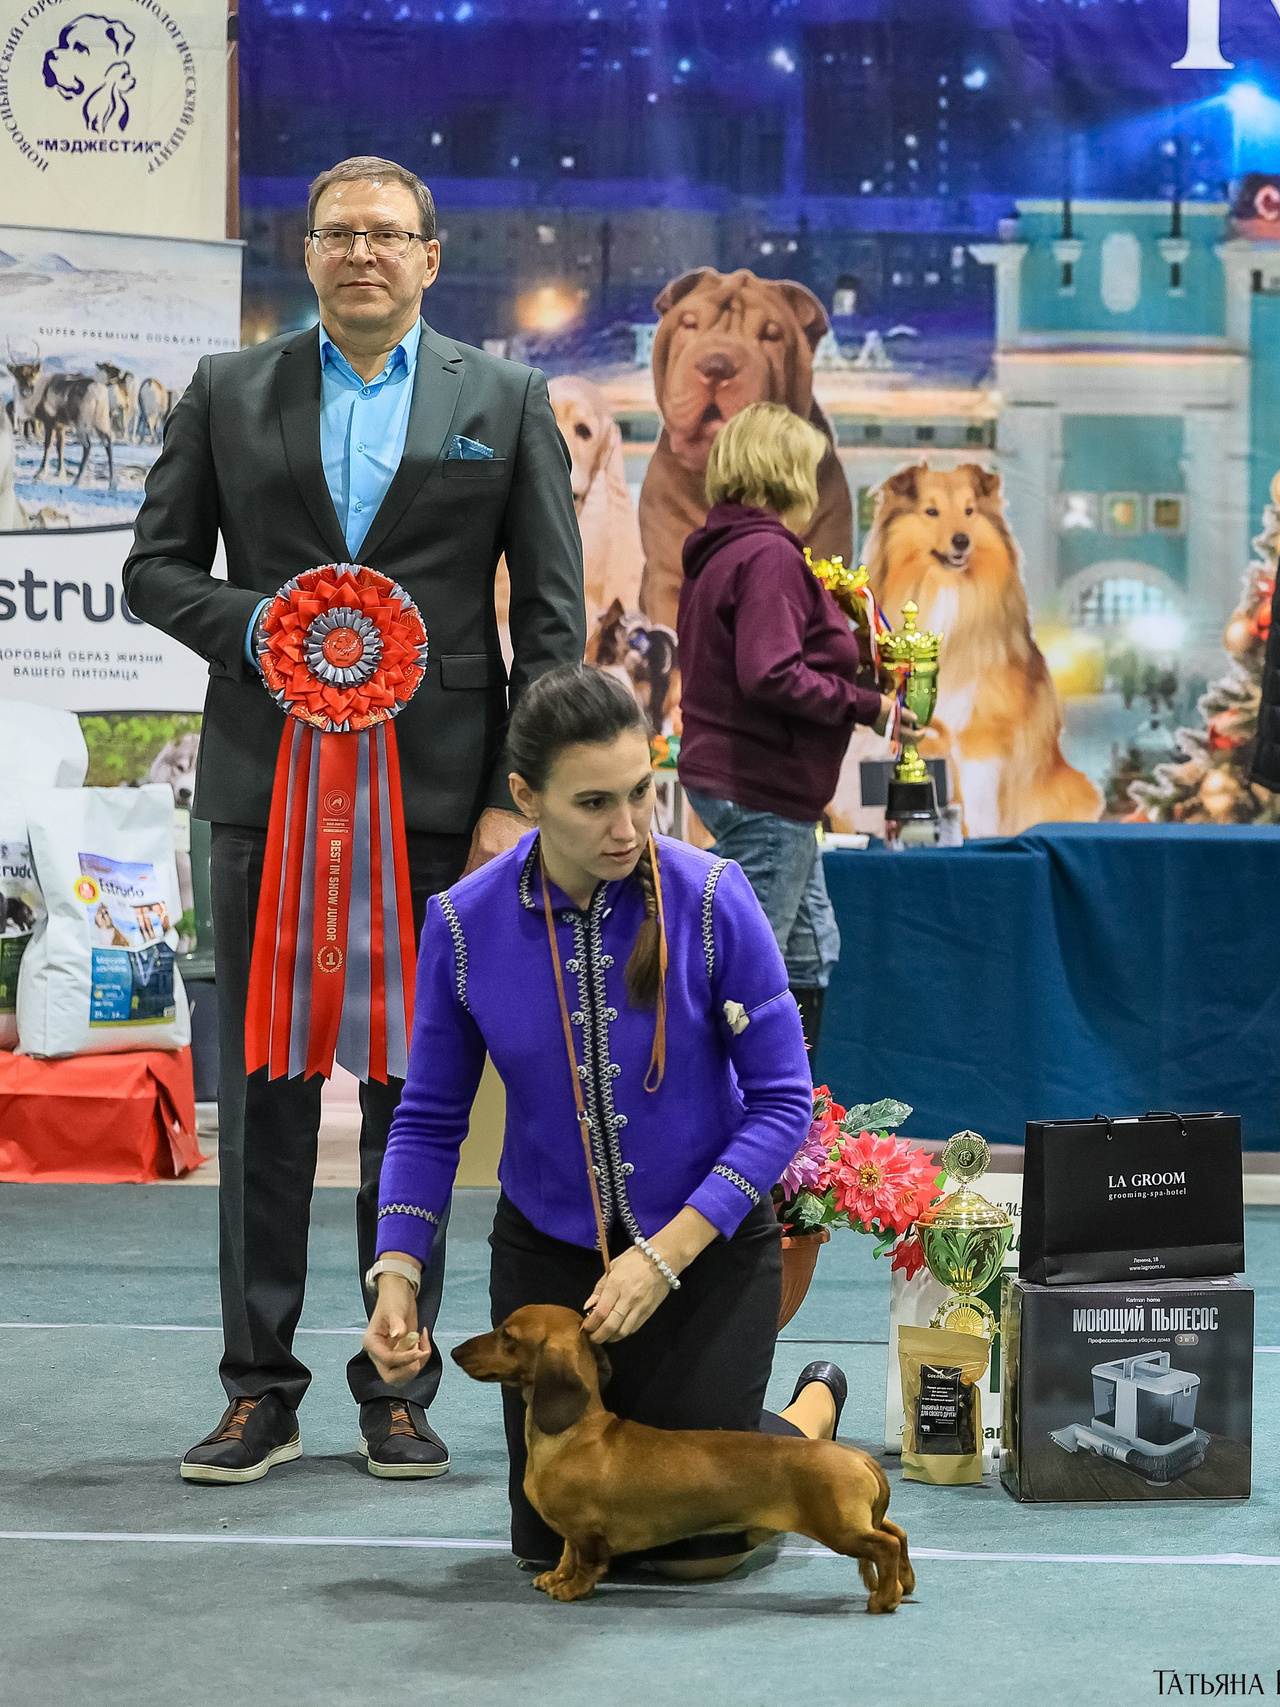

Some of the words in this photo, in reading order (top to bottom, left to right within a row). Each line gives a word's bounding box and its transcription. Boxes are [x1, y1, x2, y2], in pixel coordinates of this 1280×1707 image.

[37, 139, 162, 154] "МЭДЖЕСТИК"
[68, 651, 110, 663] ОБРАЗ
[13, 666, 66, 679] ВАШЕГО
[72, 667, 140, 681] ПИТОМЦА
[330, 839, 342, 864] BEST
[329, 864, 340, 875] IN
[328, 876, 341, 905] SHOW
[326, 906, 339, 941] JUNIOR
[325, 952, 336, 966] 1
[1108, 1175, 1127, 1188] LA
[1131, 1171, 1186, 1187] GROOM
[1073, 1305, 1145, 1334] МОЮЩИЙ
[1151, 1307, 1219, 1331] ПЫЛЕСОС
